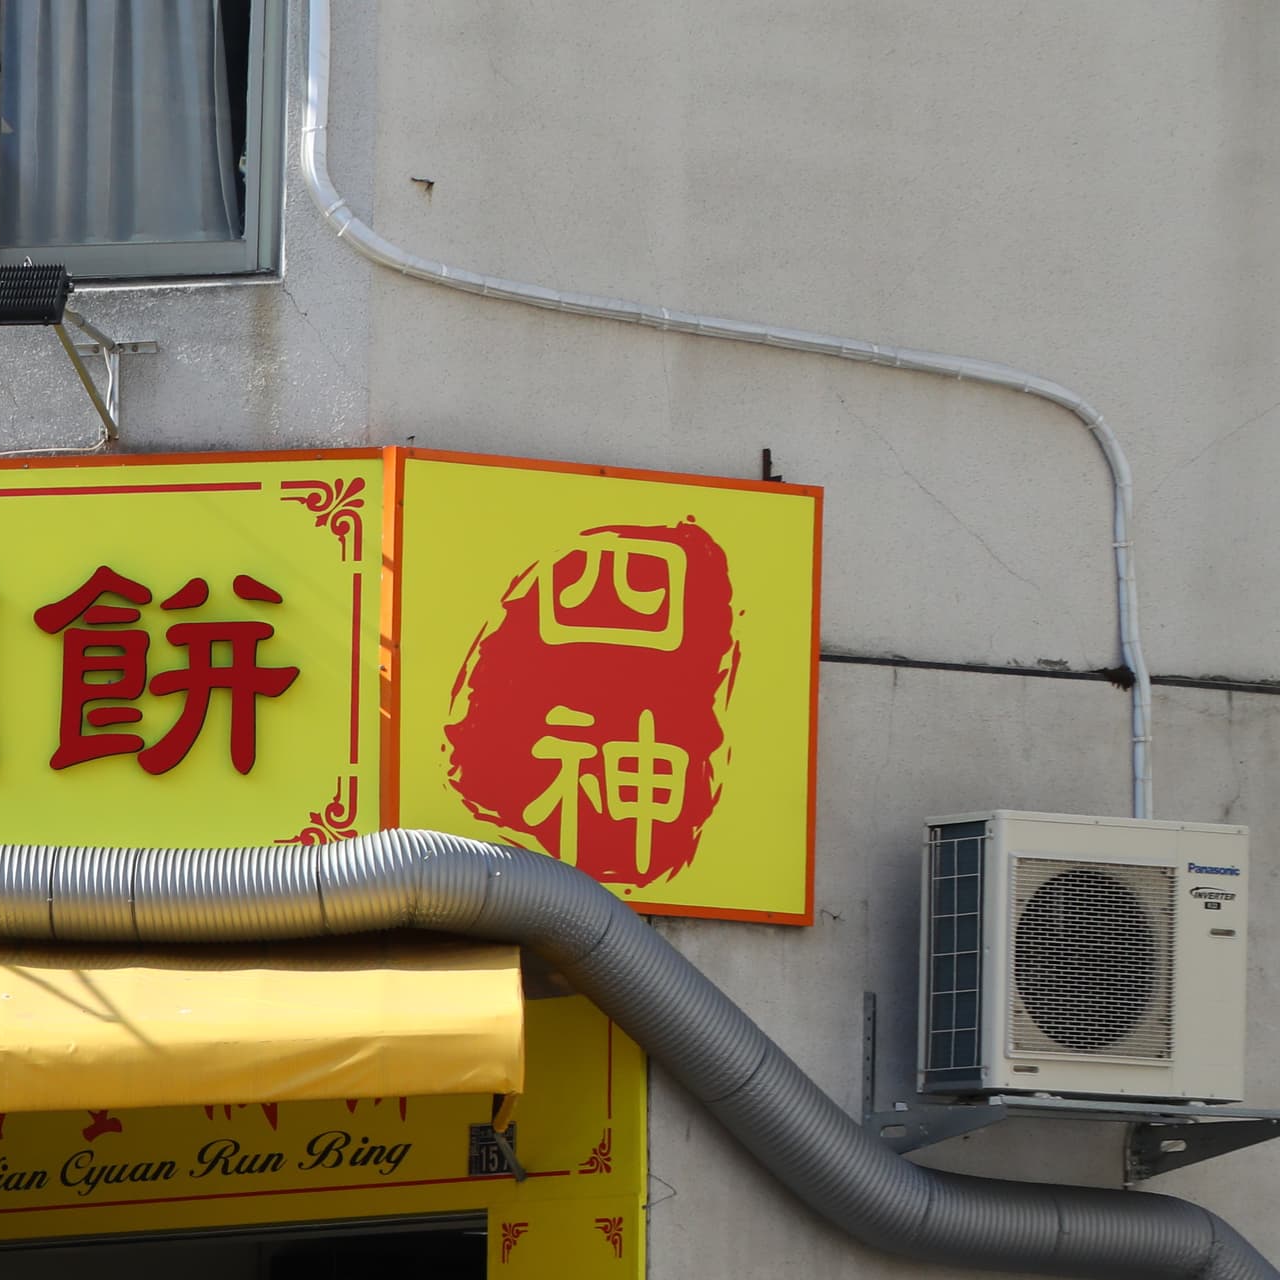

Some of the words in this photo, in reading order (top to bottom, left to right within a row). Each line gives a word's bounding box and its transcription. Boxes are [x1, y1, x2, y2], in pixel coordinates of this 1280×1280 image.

[522, 532, 687, 874] 四神
[1188, 861, 1240, 877] Panasonic
[187, 1138, 288, 1181] Run
[297, 1134, 414, 1176] Bing
